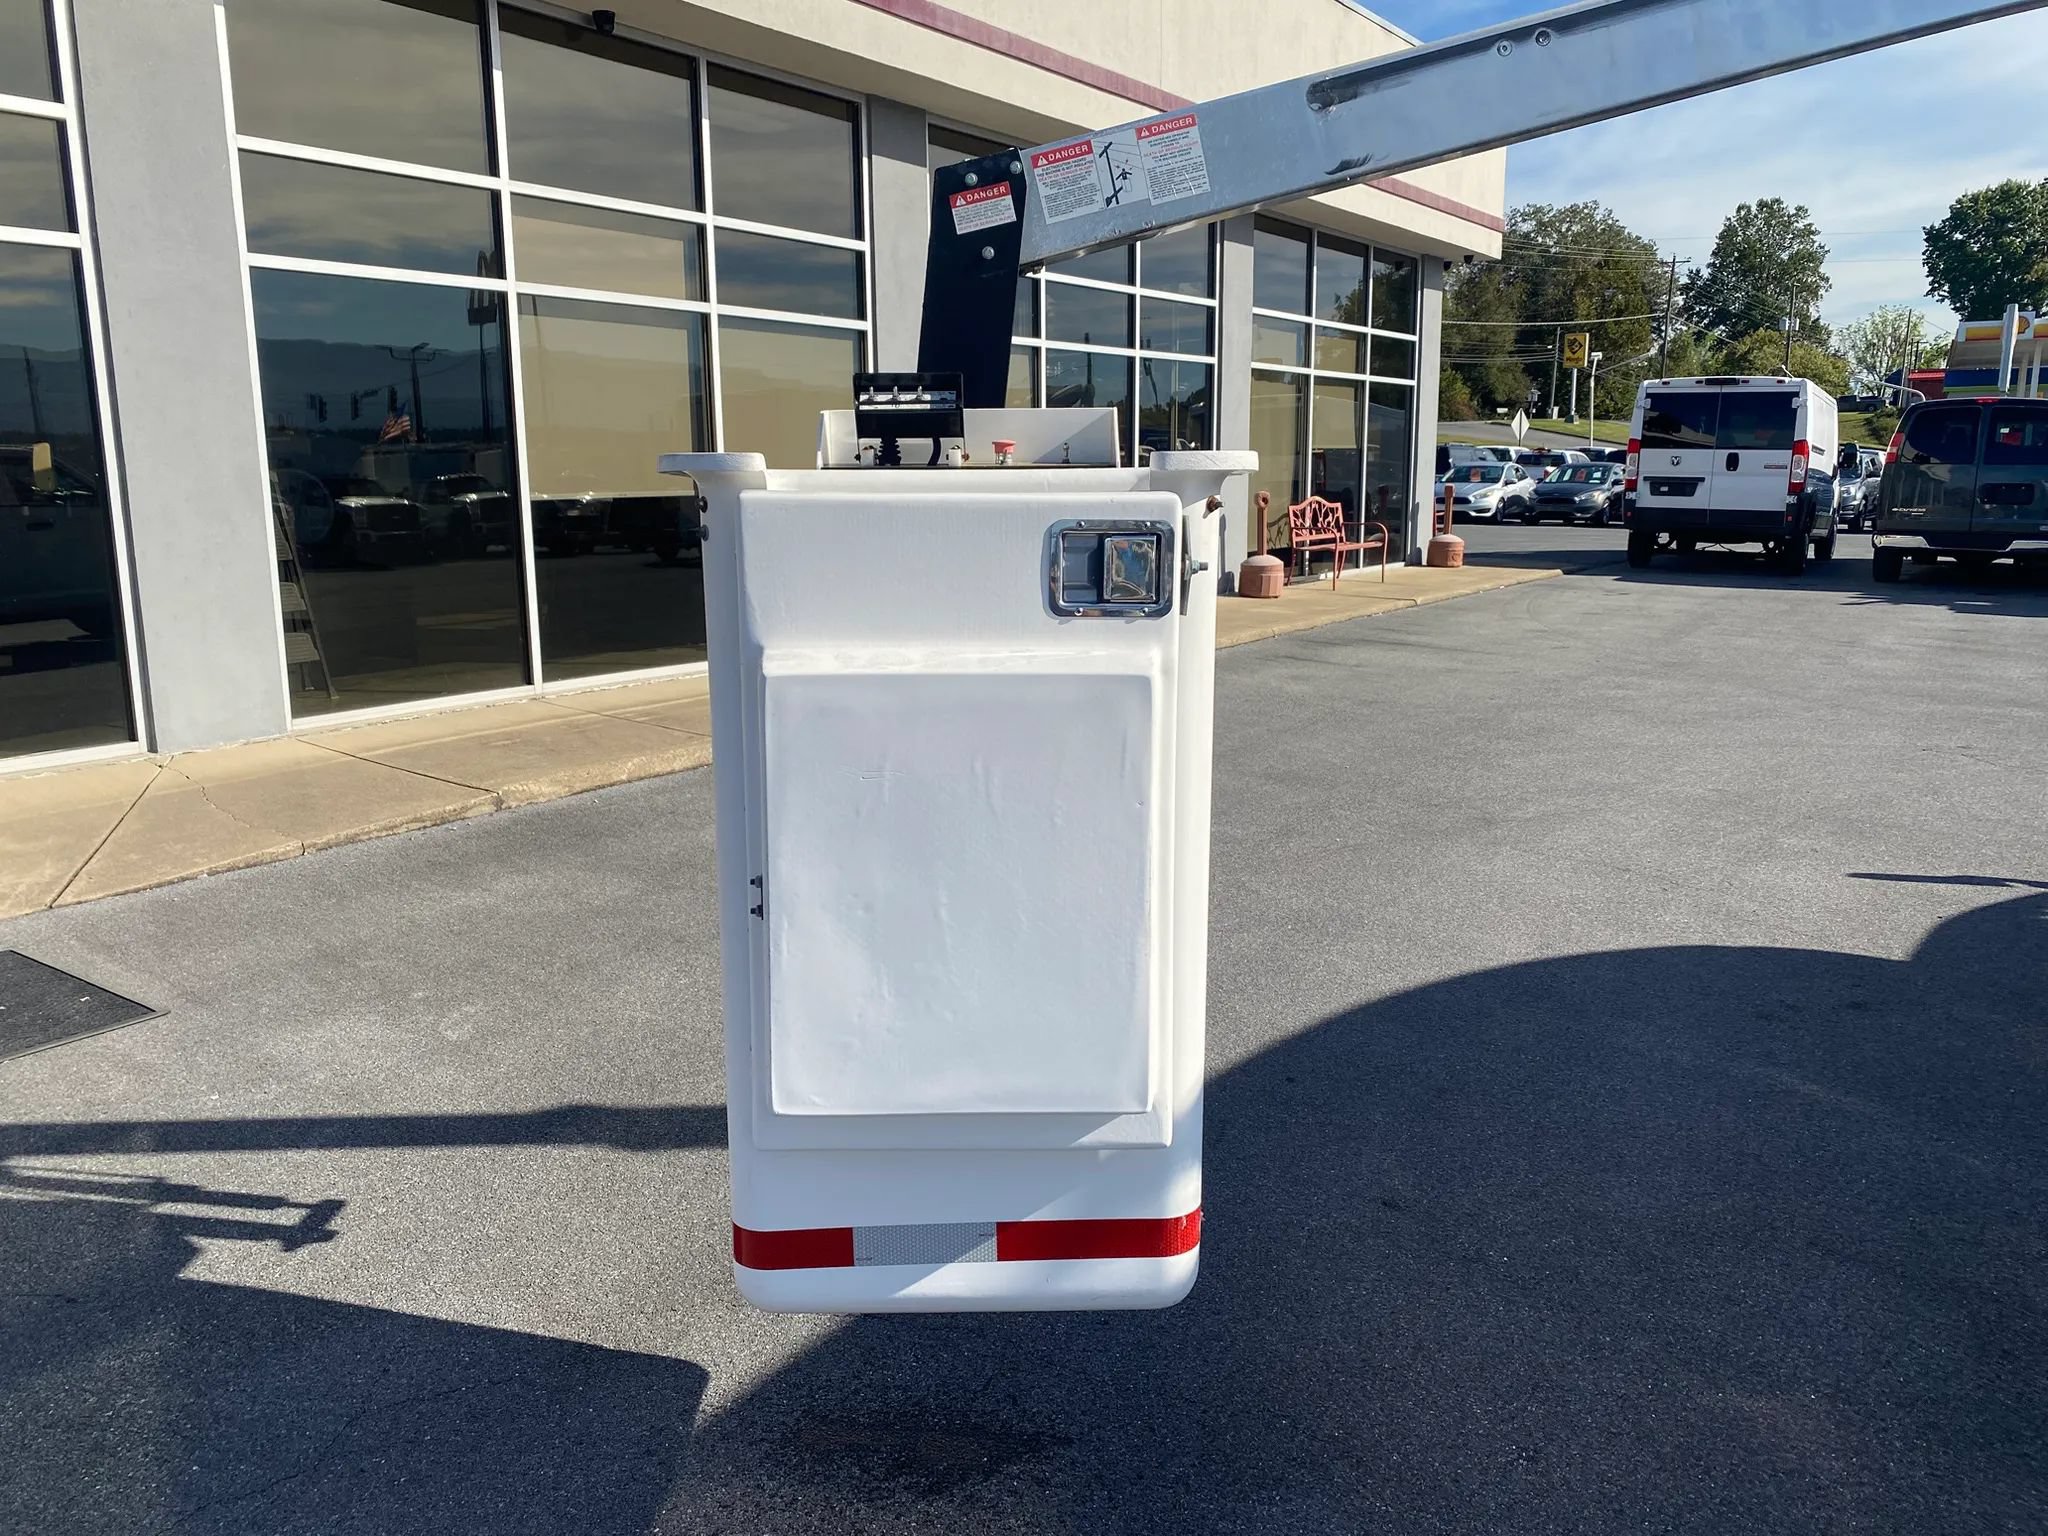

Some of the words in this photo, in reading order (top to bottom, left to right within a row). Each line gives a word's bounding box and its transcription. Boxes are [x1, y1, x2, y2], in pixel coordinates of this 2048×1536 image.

[1151, 117, 1193, 134] DANGER
[1048, 144, 1088, 161] DANGER
[966, 186, 1006, 202] DANGER
